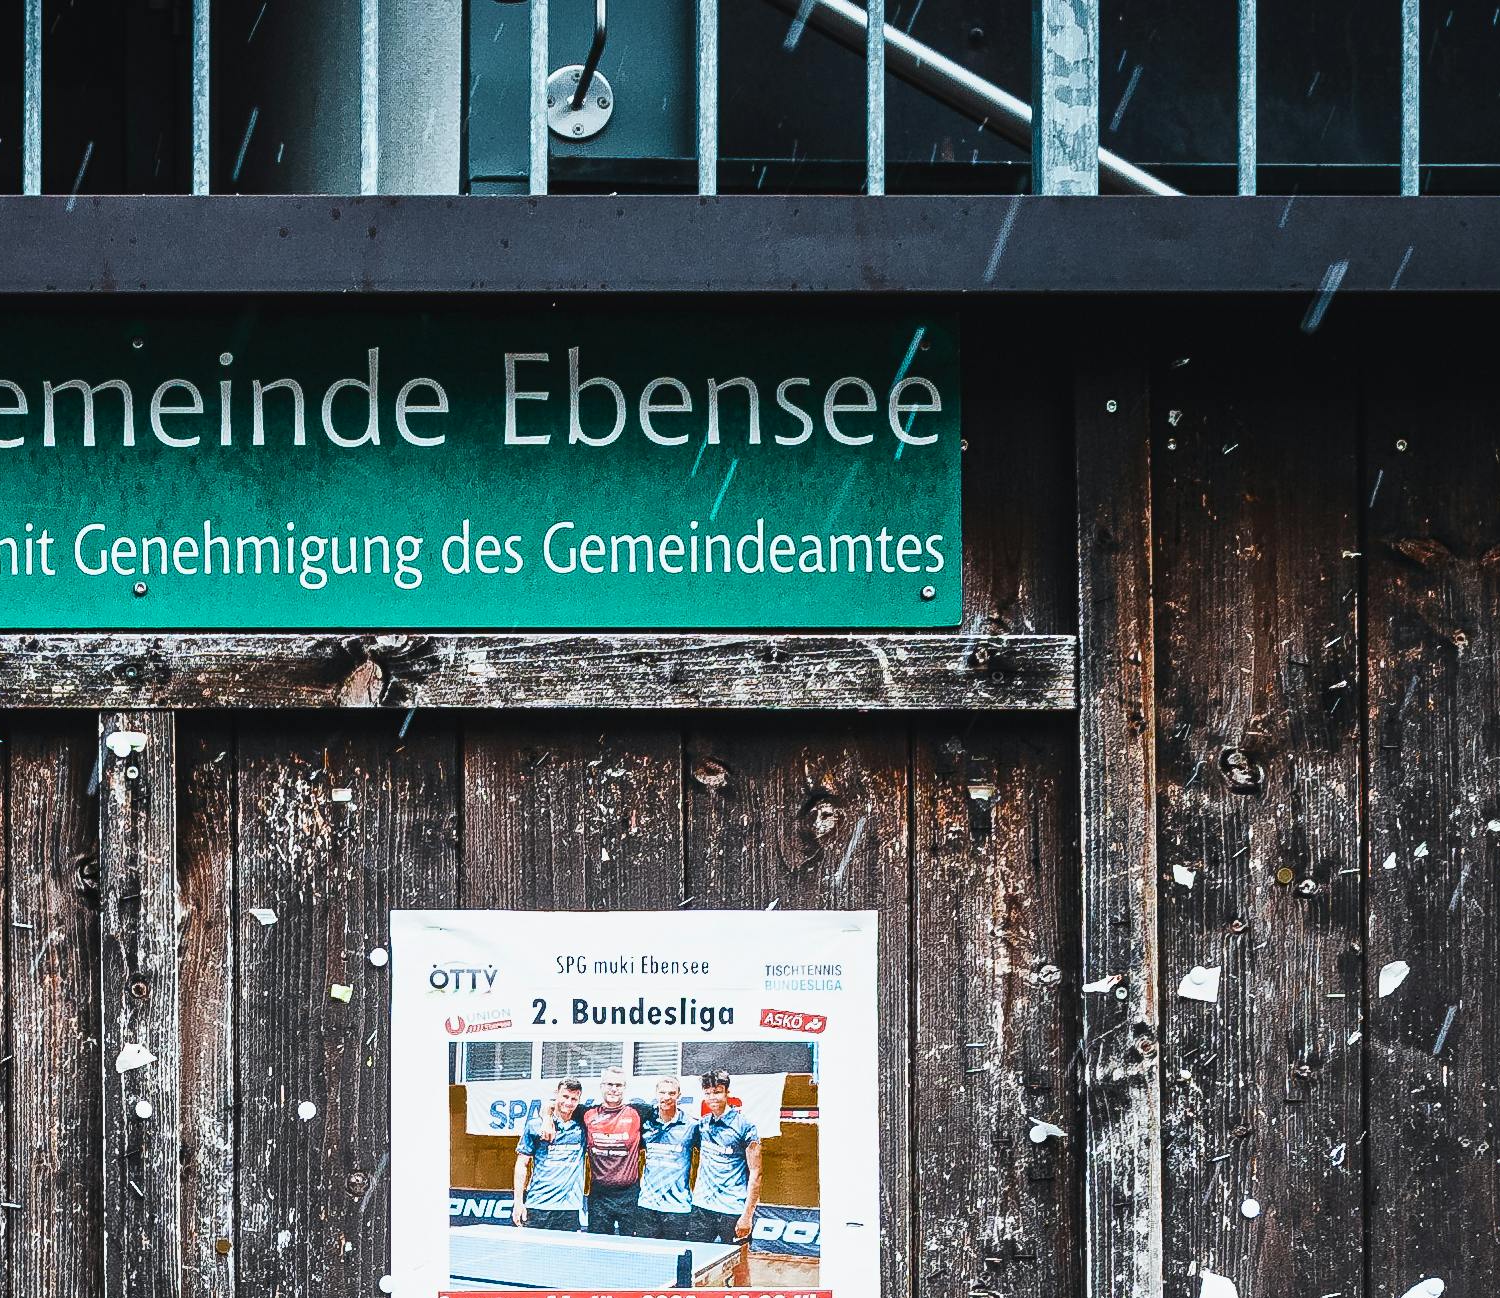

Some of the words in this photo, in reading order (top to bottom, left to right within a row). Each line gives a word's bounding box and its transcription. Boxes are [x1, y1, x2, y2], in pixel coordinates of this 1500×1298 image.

[503, 347, 942, 447] Ebensee
[74, 519, 424, 591] Genehmigung
[441, 518, 524, 575] des
[543, 518, 945, 575] Gemeindeamtes
[556, 955, 587, 975] SPG
[594, 955, 634, 975] muki
[641, 955, 710, 975] Ebensee
[765, 964, 842, 977] TISCHTENNIS
[765, 978, 843, 992] BUNDESLIGA
[466, 1007, 512, 1024] UNION
[531, 998, 558, 1025] 2.
[572, 997, 734, 1032] Bundesliga
